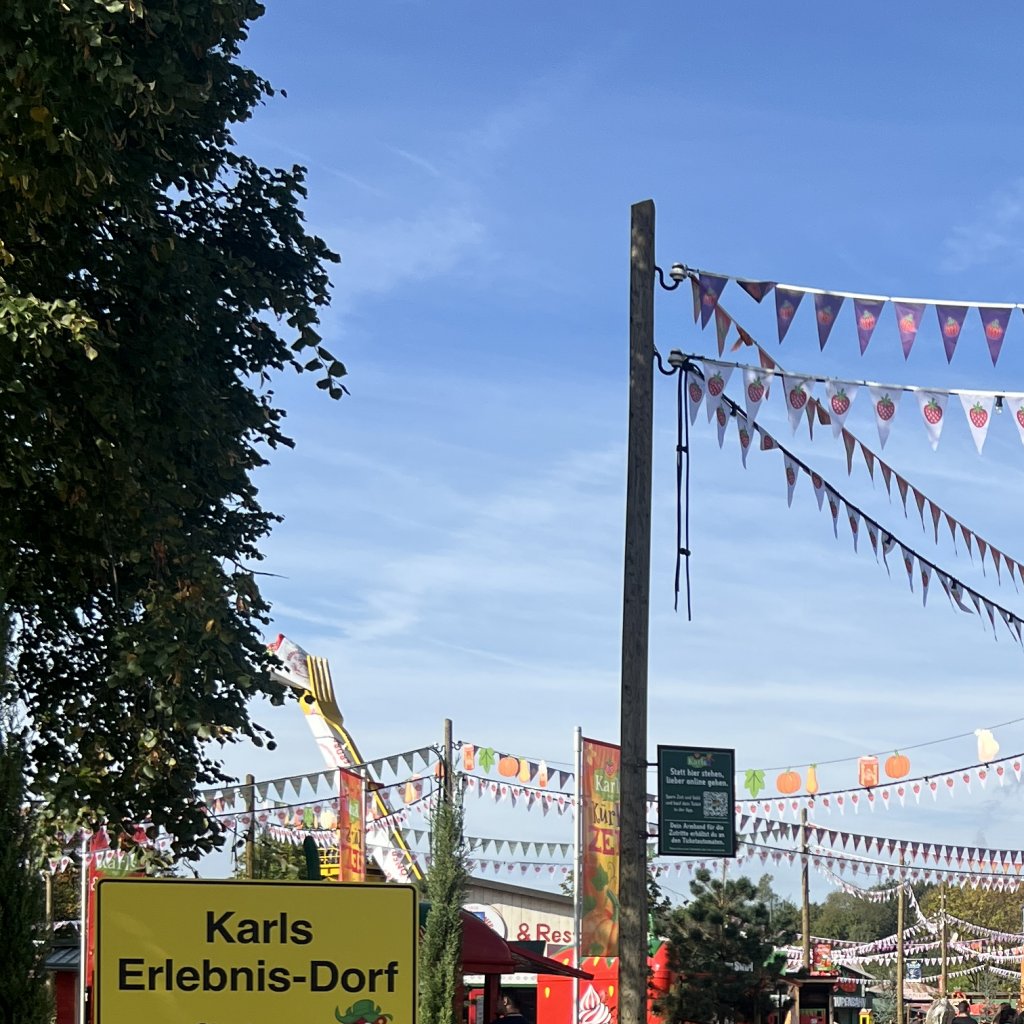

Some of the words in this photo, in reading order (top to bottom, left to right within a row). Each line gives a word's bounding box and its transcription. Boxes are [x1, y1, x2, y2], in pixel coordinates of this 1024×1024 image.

[666, 776, 685, 784] lieber
[686, 777, 706, 785] online
[670, 767, 686, 776] Statt
[593, 800, 620, 826] Kür
[588, 825, 620, 856] ZE
[206, 911, 313, 945] Karls
[517, 923, 531, 941] &
[537, 923, 576, 943] Res
[118, 958, 399, 993] Erlebnis-Dorf
